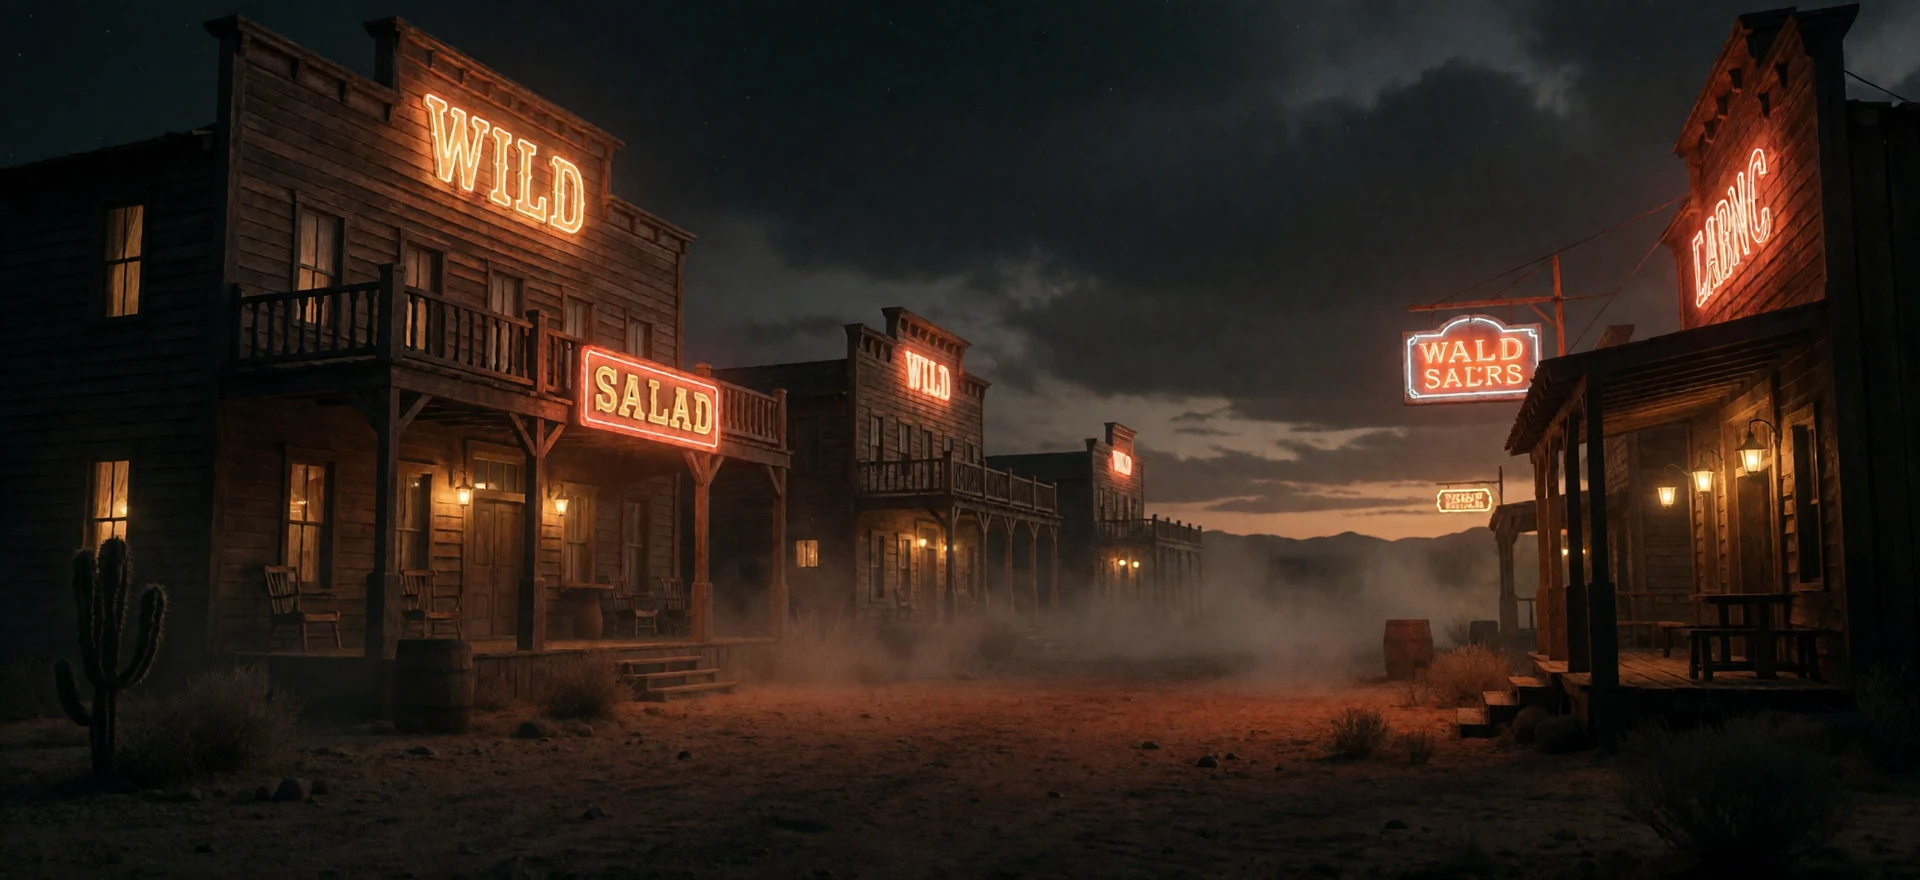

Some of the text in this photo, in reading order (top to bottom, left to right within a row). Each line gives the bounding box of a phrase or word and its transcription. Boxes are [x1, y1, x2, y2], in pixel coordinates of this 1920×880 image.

[424, 94, 585, 234] WILD
[905, 350, 951, 401] WILD
[1419, 337, 1523, 364] WALD
[595, 366, 712, 435] SALAD
